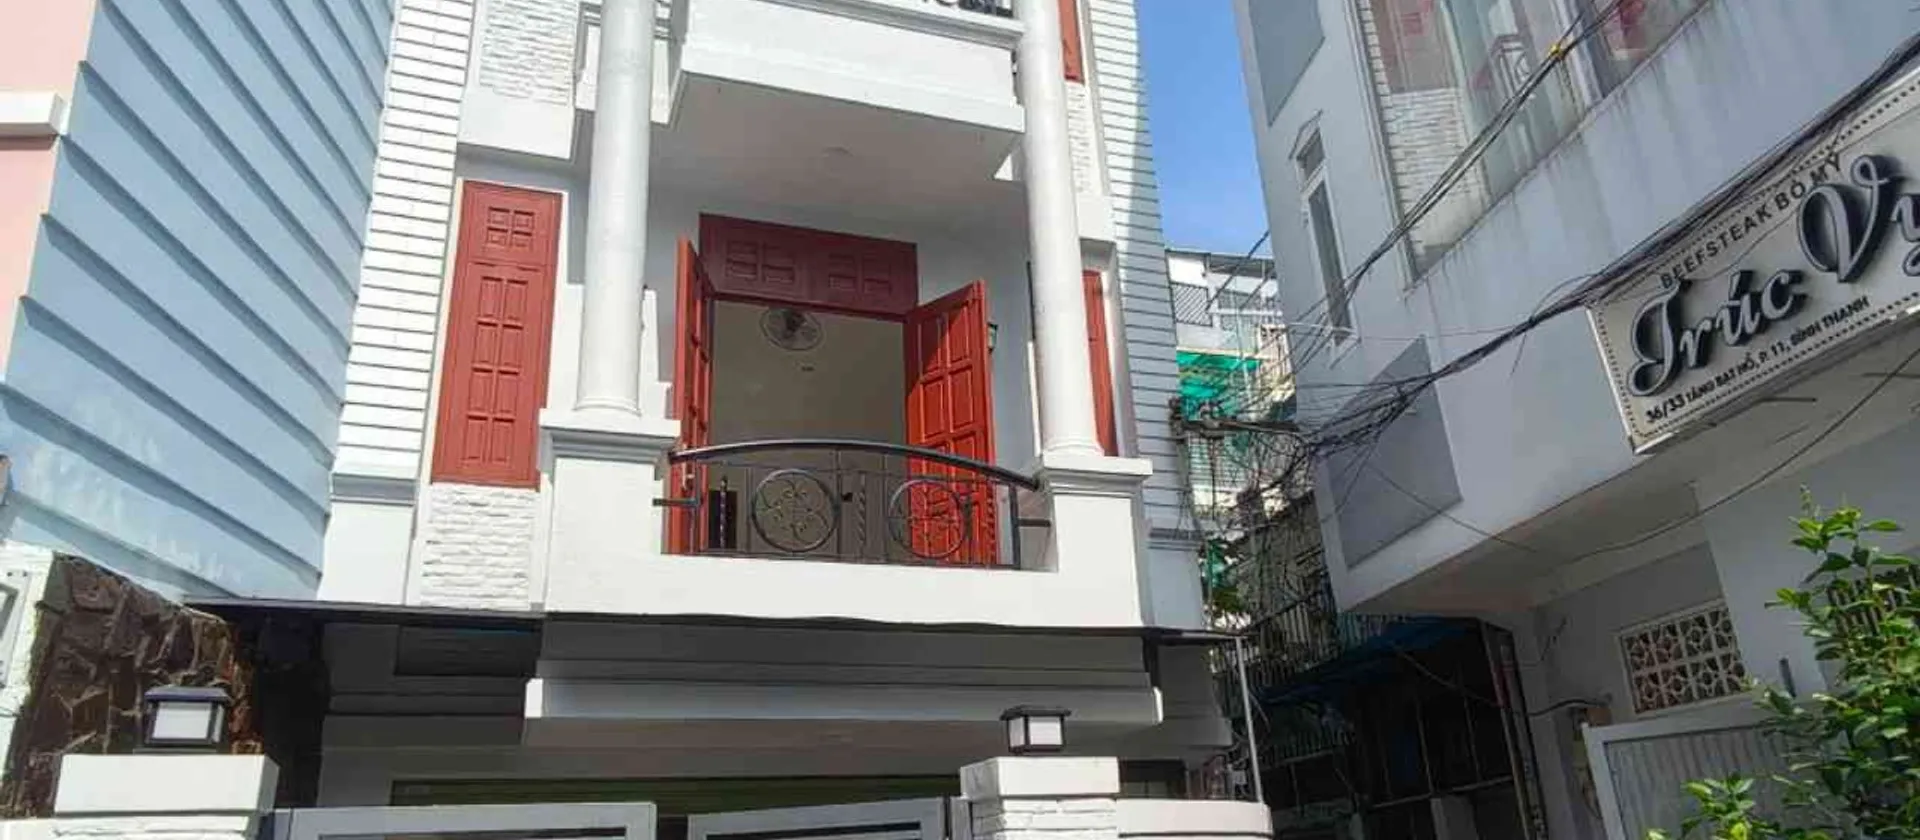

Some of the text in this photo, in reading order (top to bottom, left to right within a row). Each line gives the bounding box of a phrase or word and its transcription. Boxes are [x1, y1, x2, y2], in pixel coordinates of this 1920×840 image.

[1660, 203, 1772, 289] BEEFSTEAK
[1626, 269, 1806, 397] Trúc
[1646, 394, 1686, 424] 36/33
